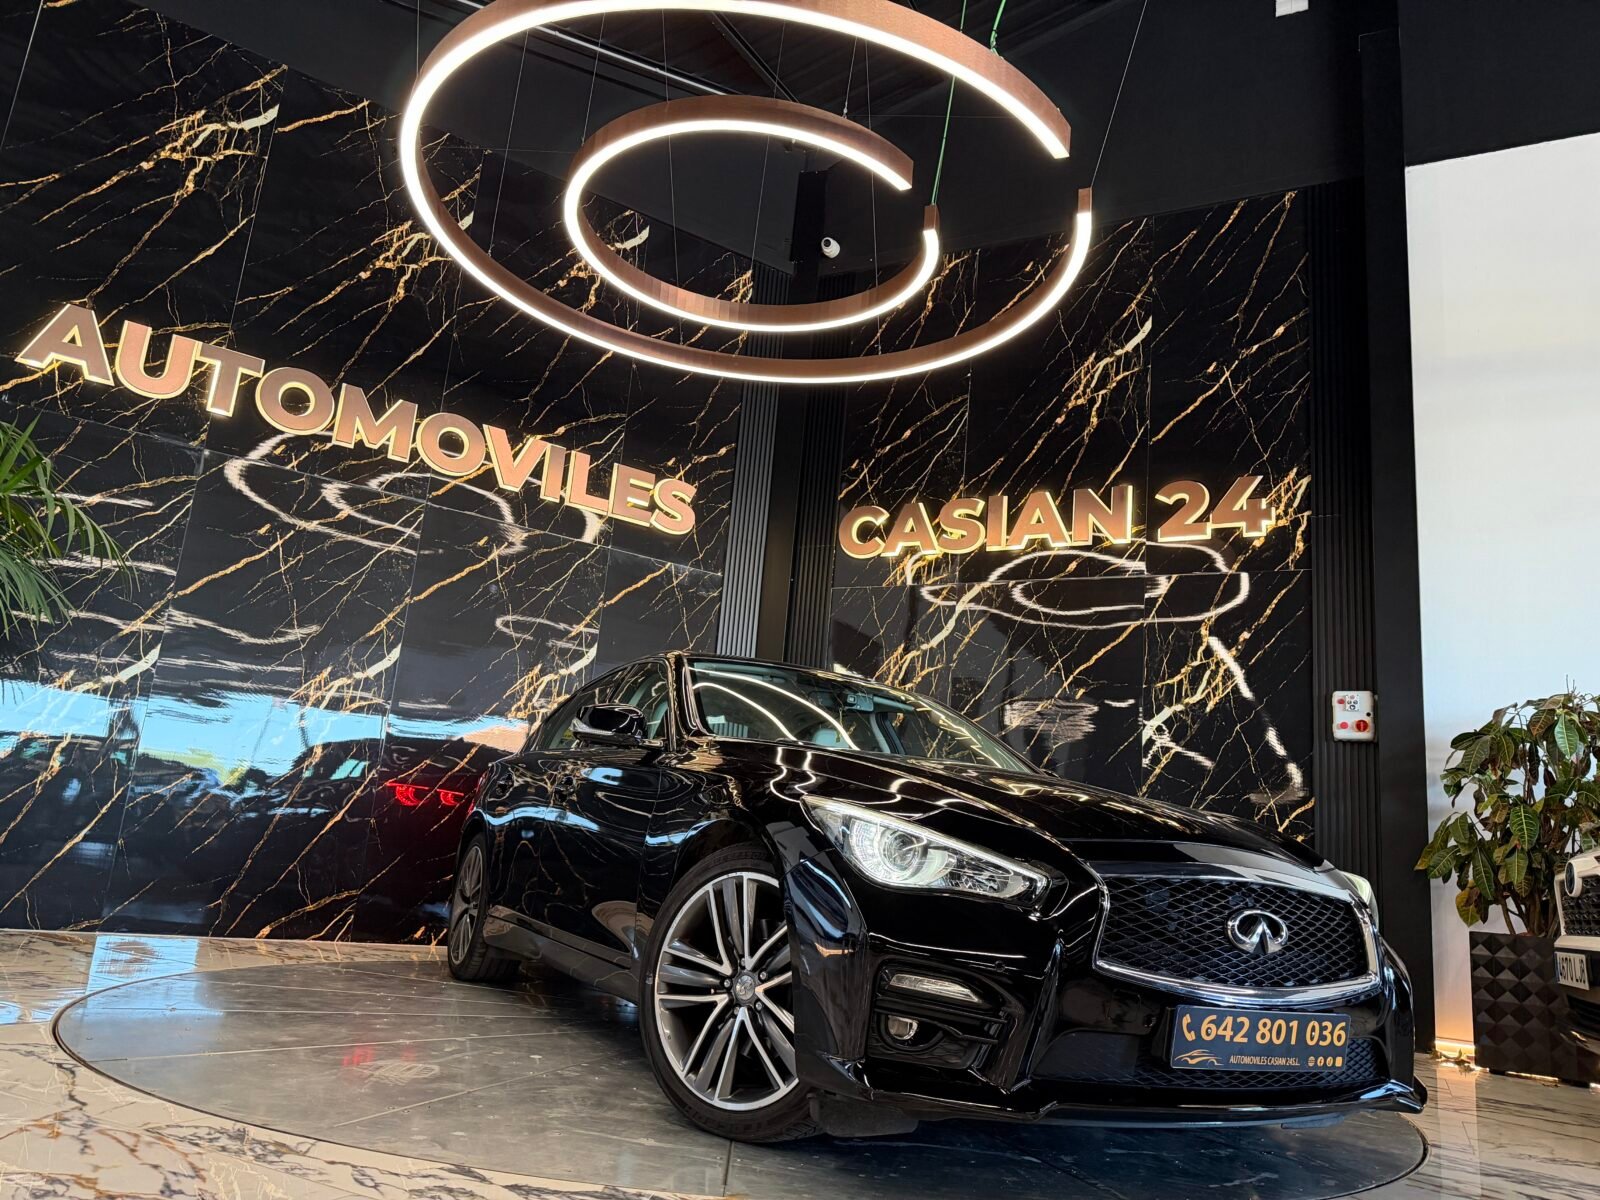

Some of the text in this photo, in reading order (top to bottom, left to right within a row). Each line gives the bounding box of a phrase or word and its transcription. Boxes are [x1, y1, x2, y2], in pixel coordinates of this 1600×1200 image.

[14, 303, 698, 536] AUTOMOVILES
[838, 475, 1277, 559] CASIAN 24
[1201, 1014, 1347, 1047] 642 801 036
[1229, 1055, 1267, 1065] AUTOMOVILES
[1267, 1056, 1287, 1066] CASIAN
